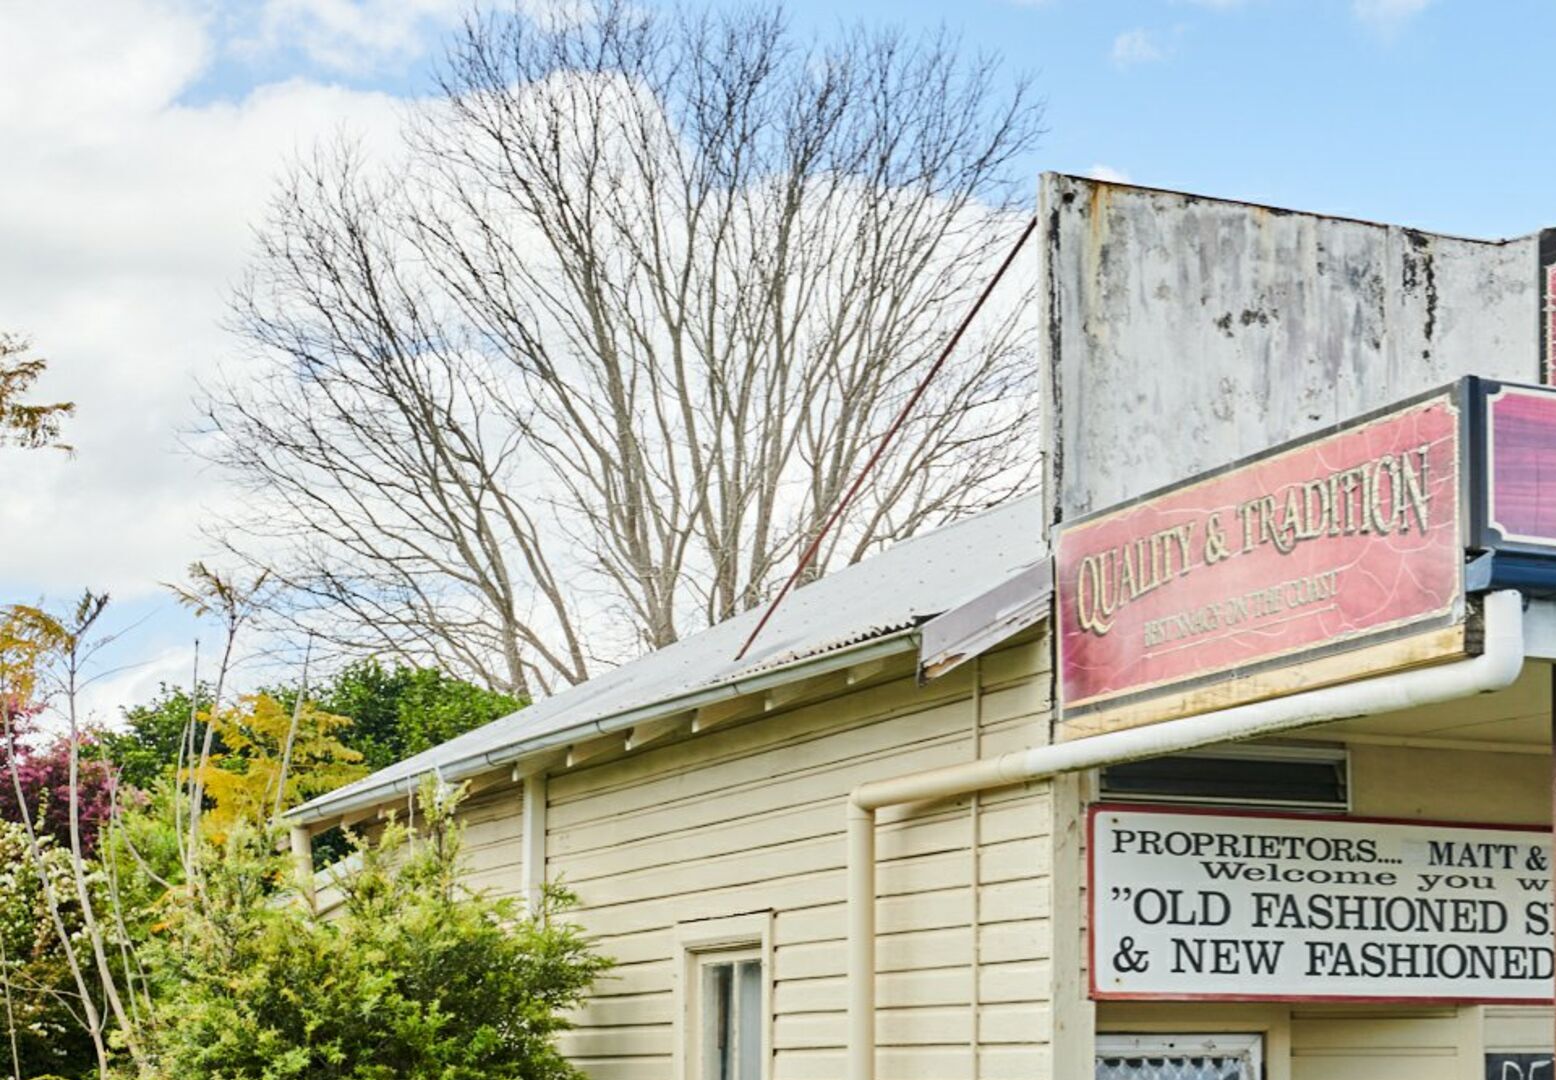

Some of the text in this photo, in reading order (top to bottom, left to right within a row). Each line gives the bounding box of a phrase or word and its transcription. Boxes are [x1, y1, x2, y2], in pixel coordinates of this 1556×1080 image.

[1077, 444, 1430, 634] QUALITY & TRADITION
[1200, 861, 1398, 886] Welcome
[1418, 874, 1495, 893] you
[1428, 840, 1518, 871] MATT
[1525, 845, 1548, 871] &
[1251, 891, 1509, 934] FASHIONED
[1112, 936, 1555, 981] & NEW FASHIONED
